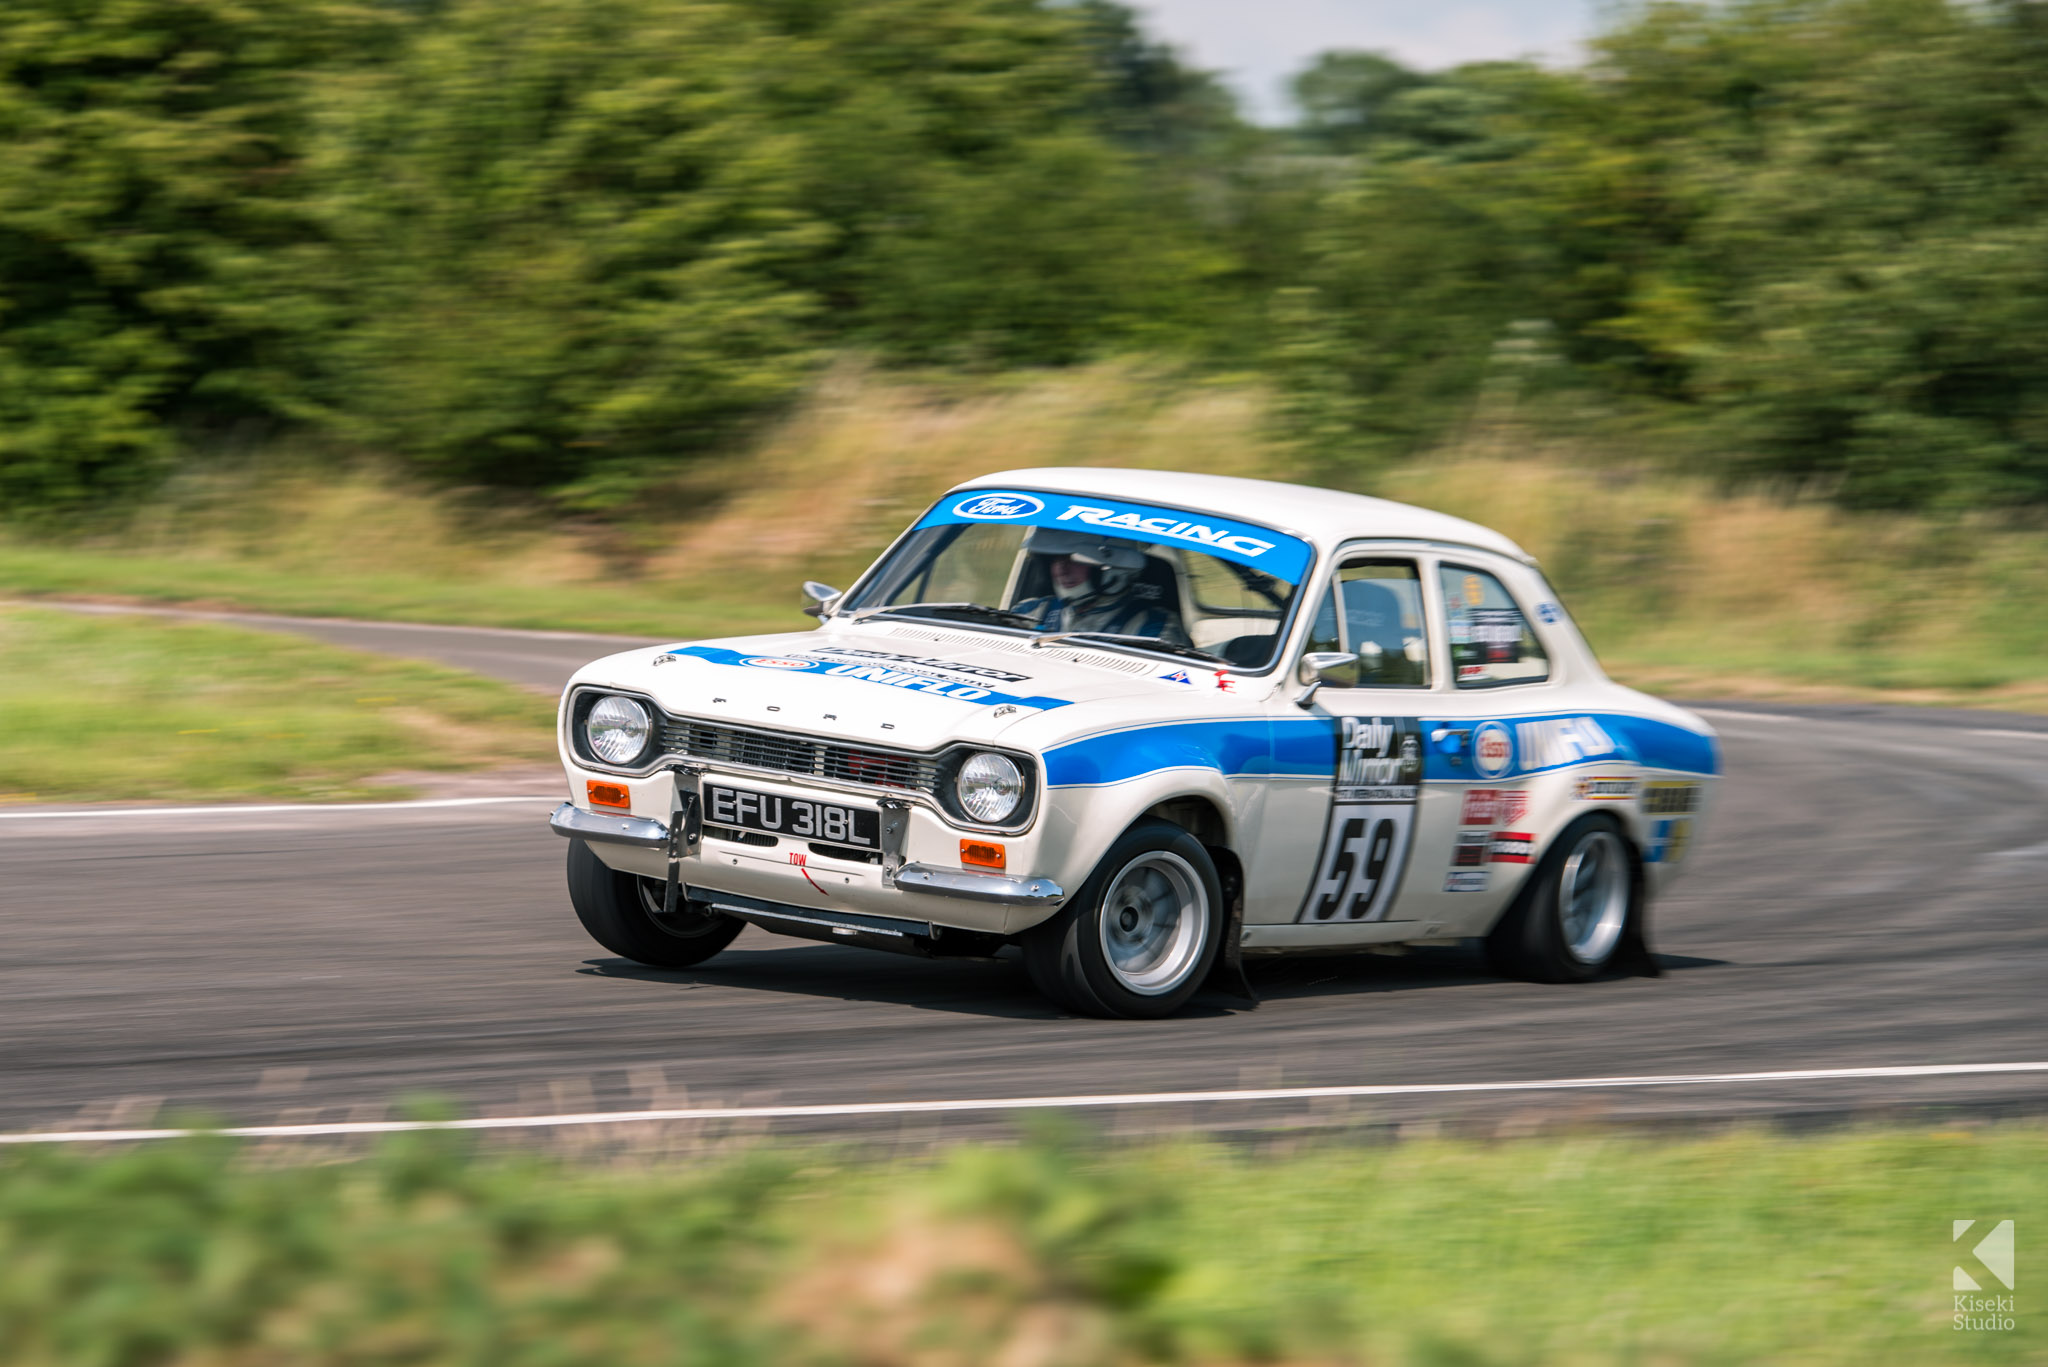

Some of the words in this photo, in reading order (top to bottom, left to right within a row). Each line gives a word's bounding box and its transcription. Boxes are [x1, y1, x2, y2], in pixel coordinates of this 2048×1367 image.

[967, 498, 1027, 516] Ford
[1056, 505, 1277, 557] RACING
[825, 664, 992, 700] UNIFLO
[713, 698, 895, 730] FORD
[1341, 716, 1394, 758] Daily
[1338, 749, 1402, 785] Mirror
[712, 787, 782, 830] EFU
[791, 802, 871, 845] 318L
[789, 852, 807, 866] TOW
[1314, 818, 1397, 919] 59
